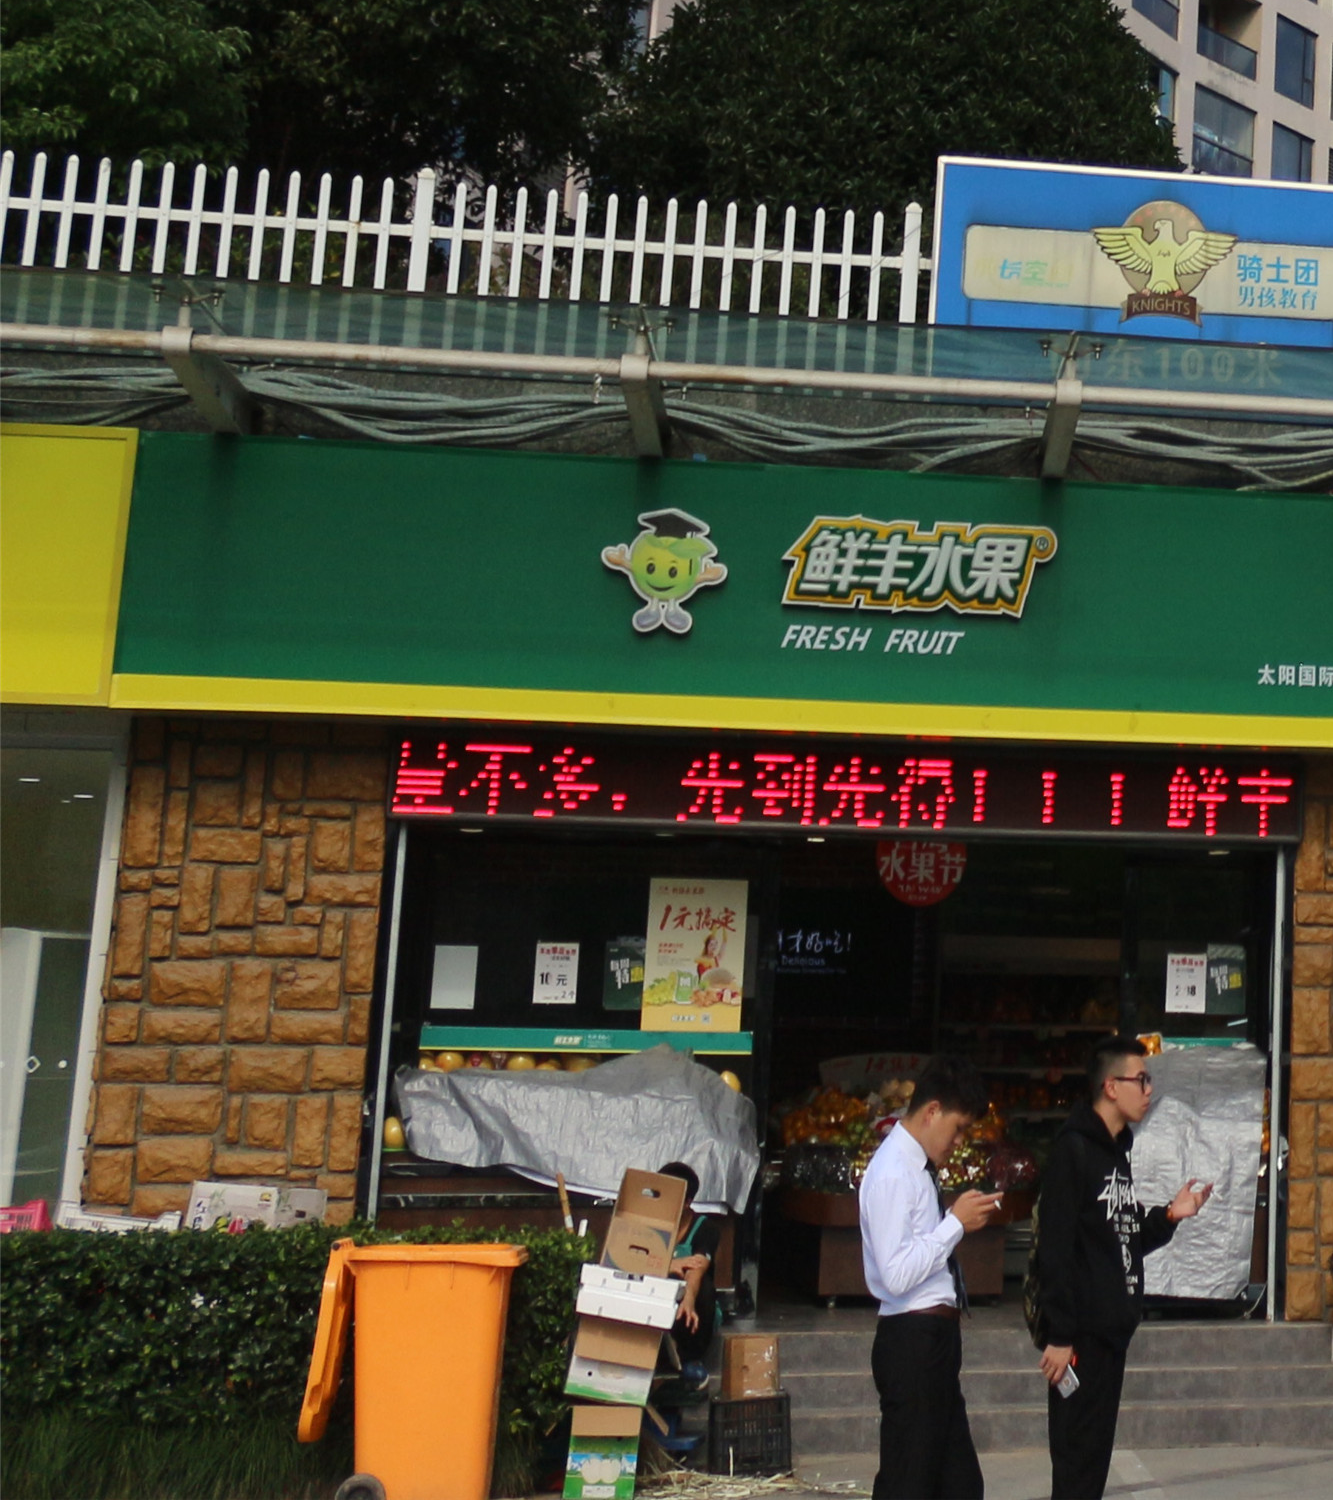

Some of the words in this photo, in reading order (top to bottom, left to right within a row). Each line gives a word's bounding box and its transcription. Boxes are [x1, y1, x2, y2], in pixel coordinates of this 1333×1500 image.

[1236, 254, 1319, 287] 骑士团
[1131, 297, 1191, 316] KNIGHTS
[1237, 285, 1318, 311] 男孩教育
[799, 530, 1029, 599] 鲜丰水果
[780, 624, 872, 652] FRESH
[884, 628, 966, 655] FRUIT
[878, 849, 967, 886] 水果节
[555, 973, 568, 987] 元
